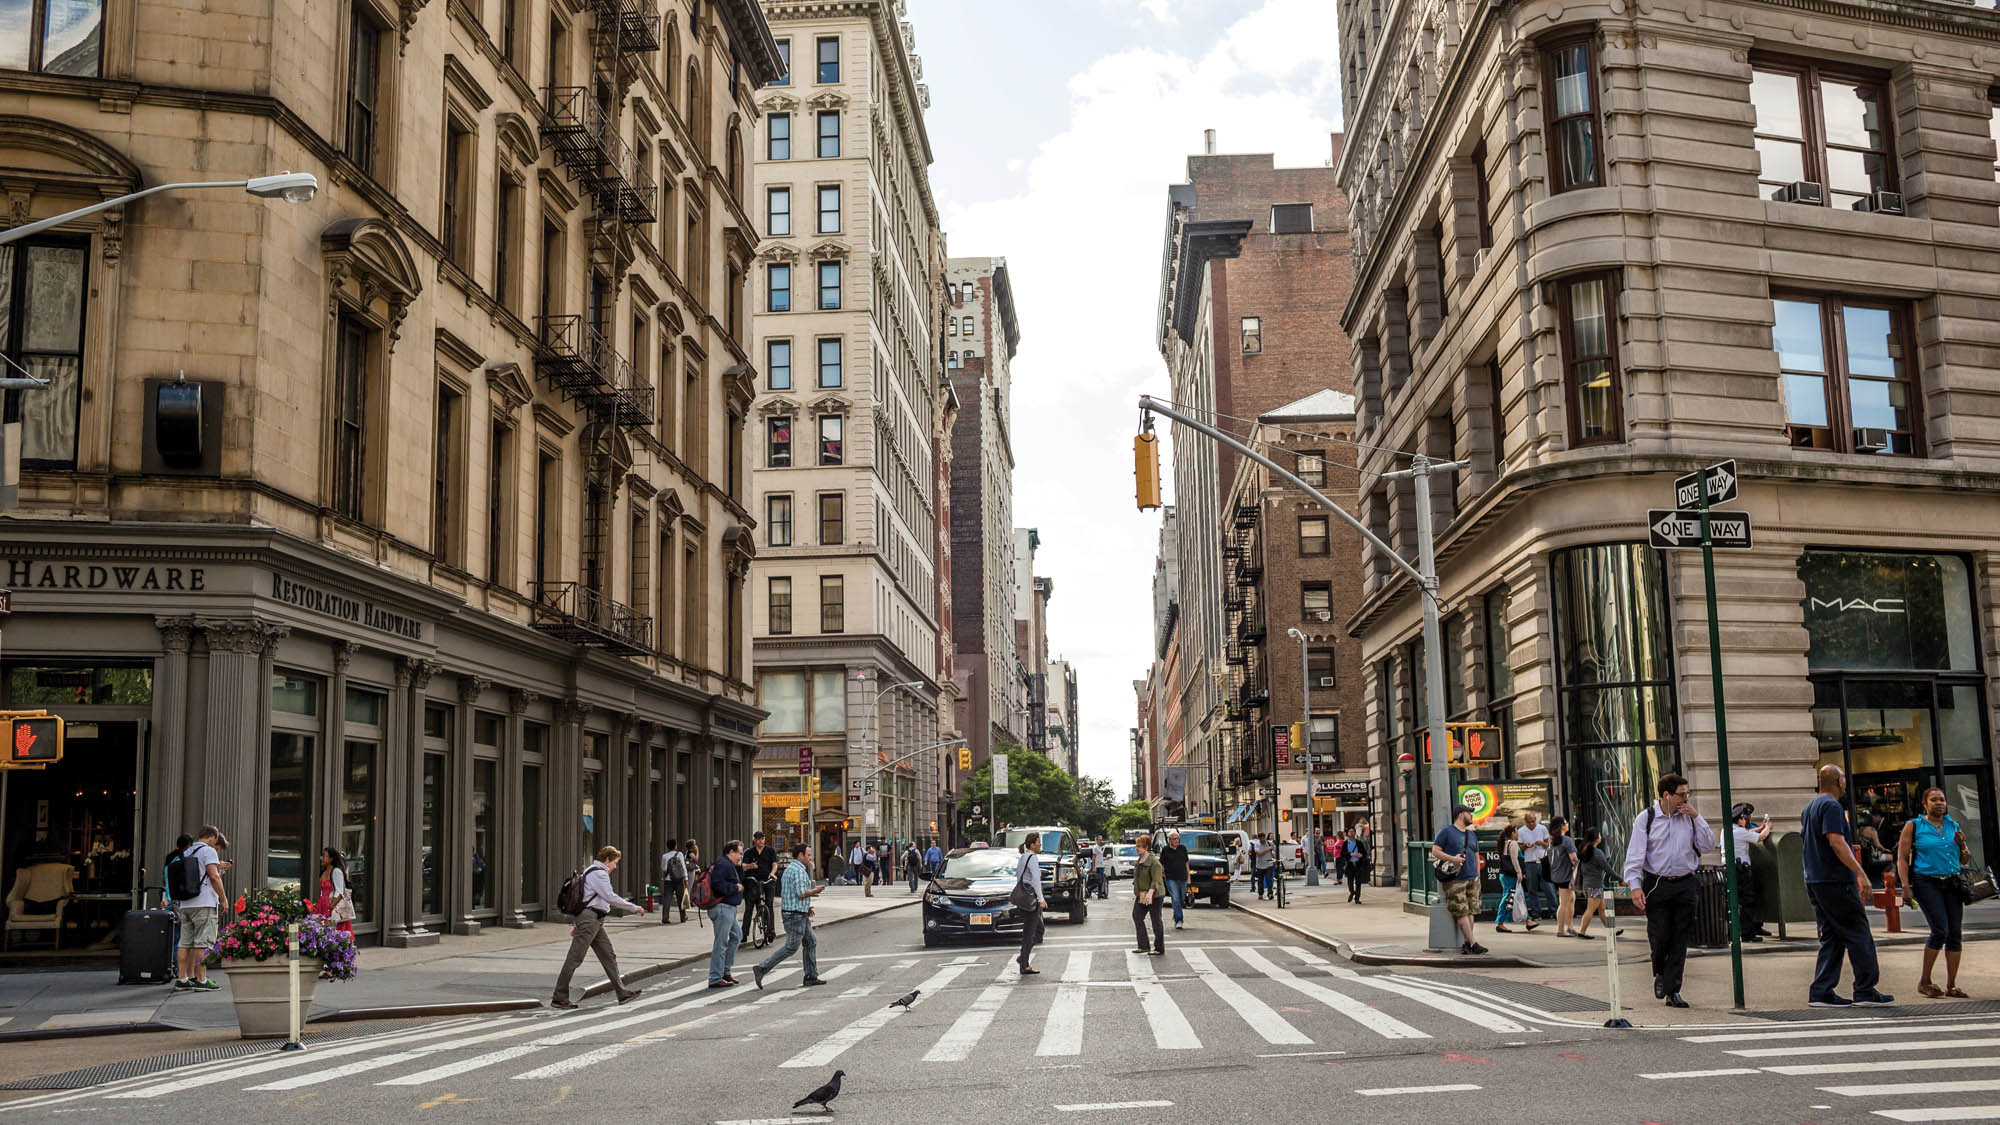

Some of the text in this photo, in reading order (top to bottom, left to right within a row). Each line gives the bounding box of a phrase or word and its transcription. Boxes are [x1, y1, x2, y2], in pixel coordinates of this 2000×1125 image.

[1681, 474, 1729, 503] ONE WAY
[1661, 521, 1741, 537] ONE WAY
[7, 559, 206, 591] HARDWARE
[272, 572, 422, 640] RESTORATION HARDWARE
[1321, 782, 1353, 790] LUCKY
[1486, 852, 1500, 860] No
